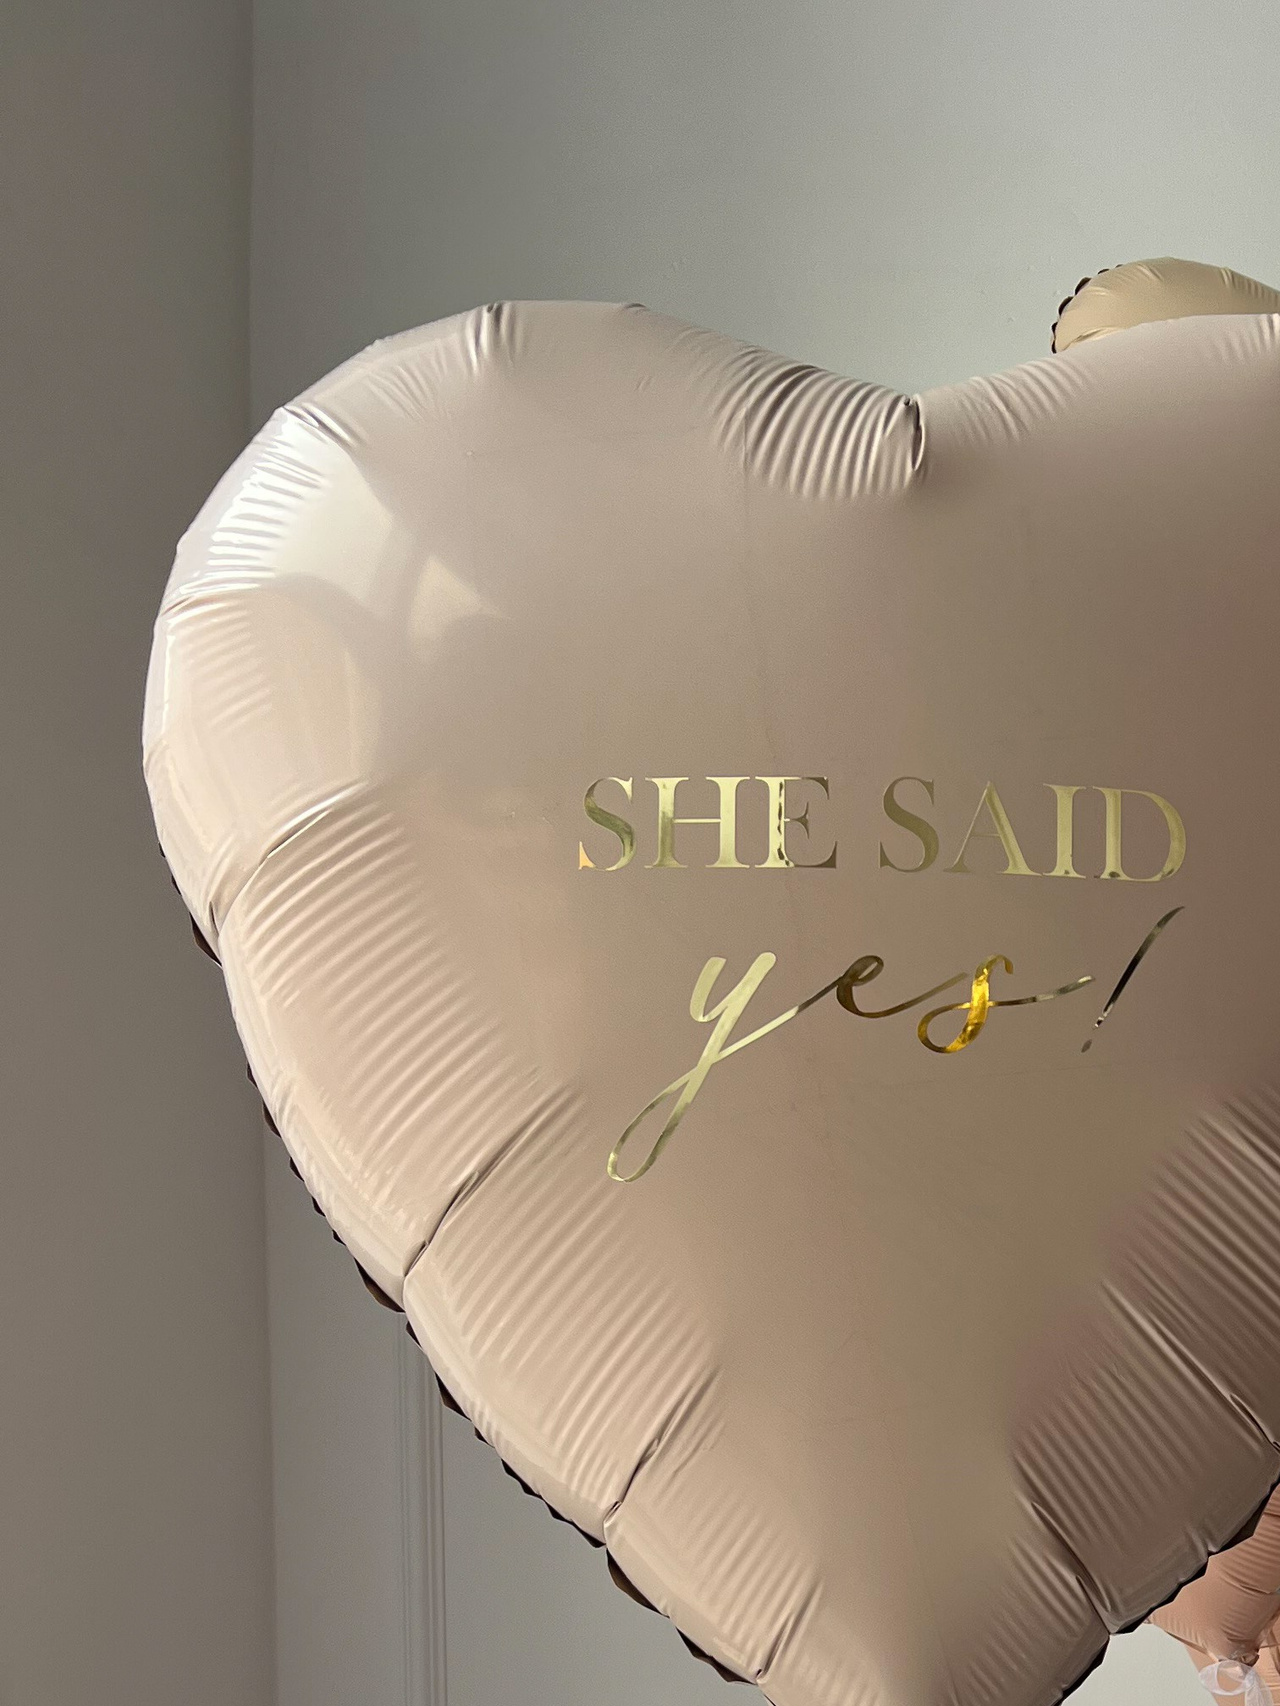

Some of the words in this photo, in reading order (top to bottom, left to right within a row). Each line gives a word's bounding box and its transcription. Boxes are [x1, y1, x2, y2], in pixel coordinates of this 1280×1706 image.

[578, 776, 838, 871] SHE
[879, 776, 1187, 882] SAID
[606, 905, 1186, 1182] yes!
